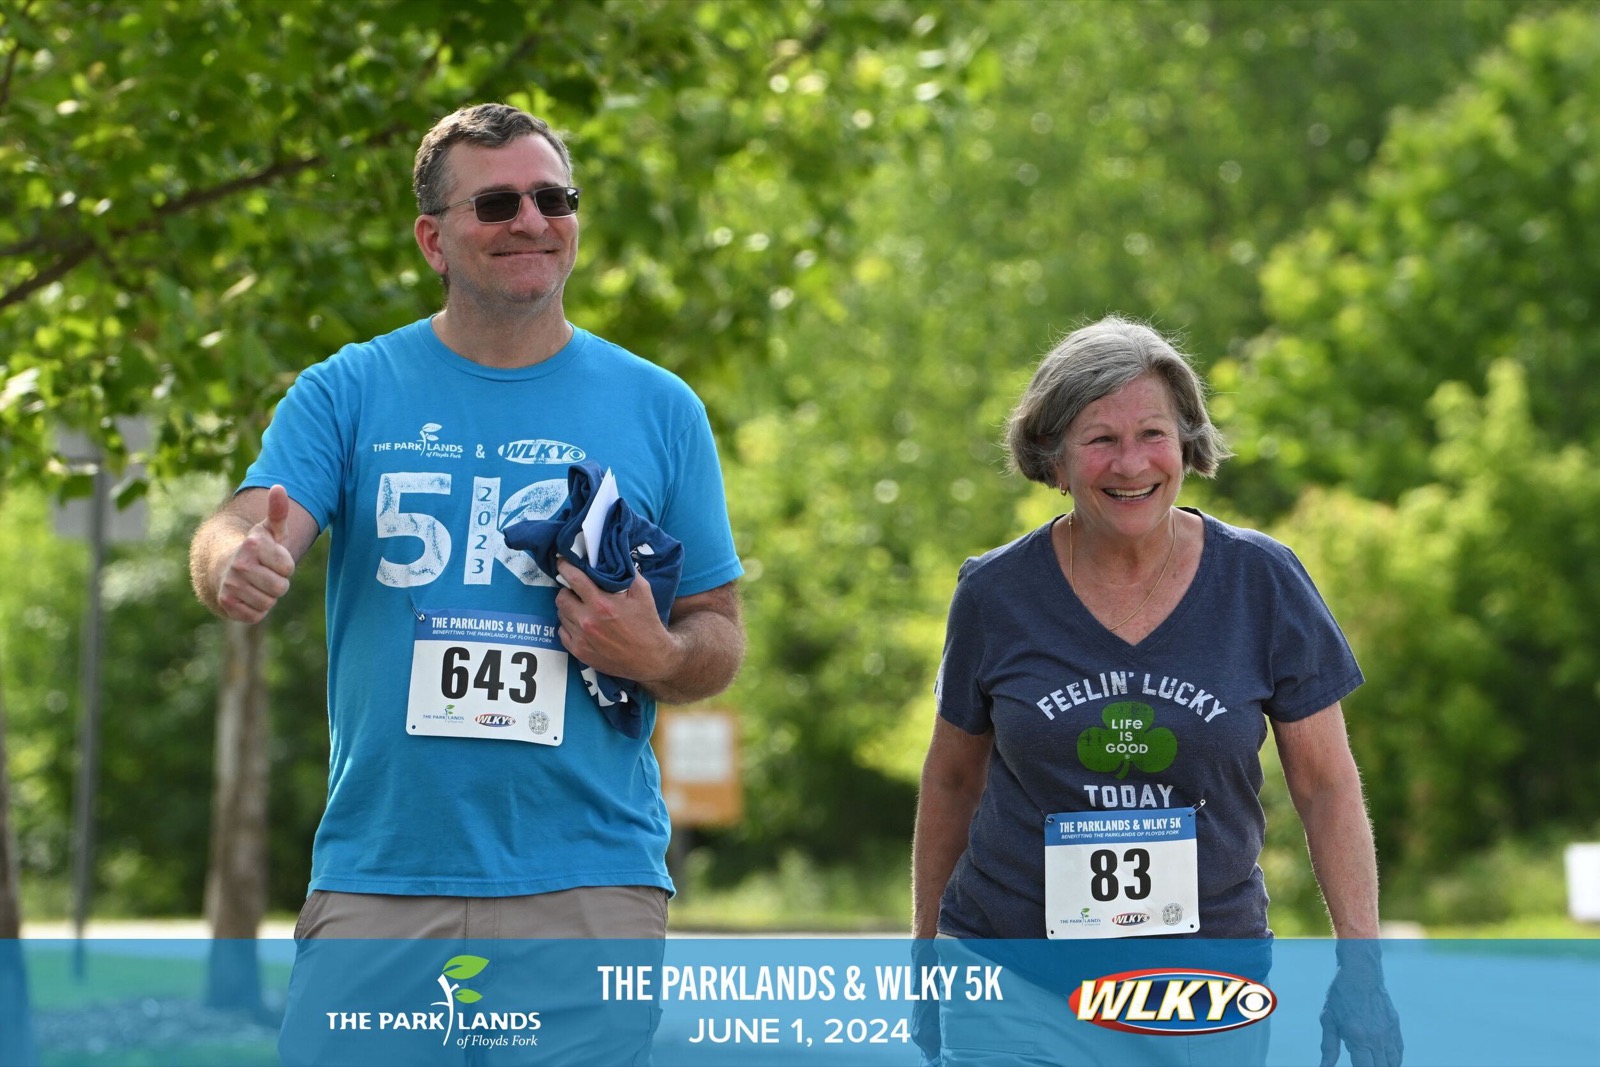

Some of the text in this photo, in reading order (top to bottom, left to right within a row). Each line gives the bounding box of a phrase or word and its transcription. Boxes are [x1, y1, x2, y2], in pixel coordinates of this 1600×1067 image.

[373, 443, 392, 452] THE
[475, 443, 485, 459] &
[505, 441, 572, 461] WLKY
[472, 486, 493, 574] 2023
[432, 617, 555, 638] THE PARKLANDS & WLKY 5K
[441, 646, 538, 704] 643
[1036, 671, 1228, 723] FEELIN' LUCKY
[477, 714, 510, 725] WLKY
[1119, 732, 1133, 742] IS
[1105, 743, 1148, 754] GOOD
[1083, 784, 1174, 808] TODAY
[1060, 817, 1181, 833] THE PARKLANDS & WLKY 5K
[1090, 848, 1151, 902] 83
[1113, 914, 1145, 924] WLKY
